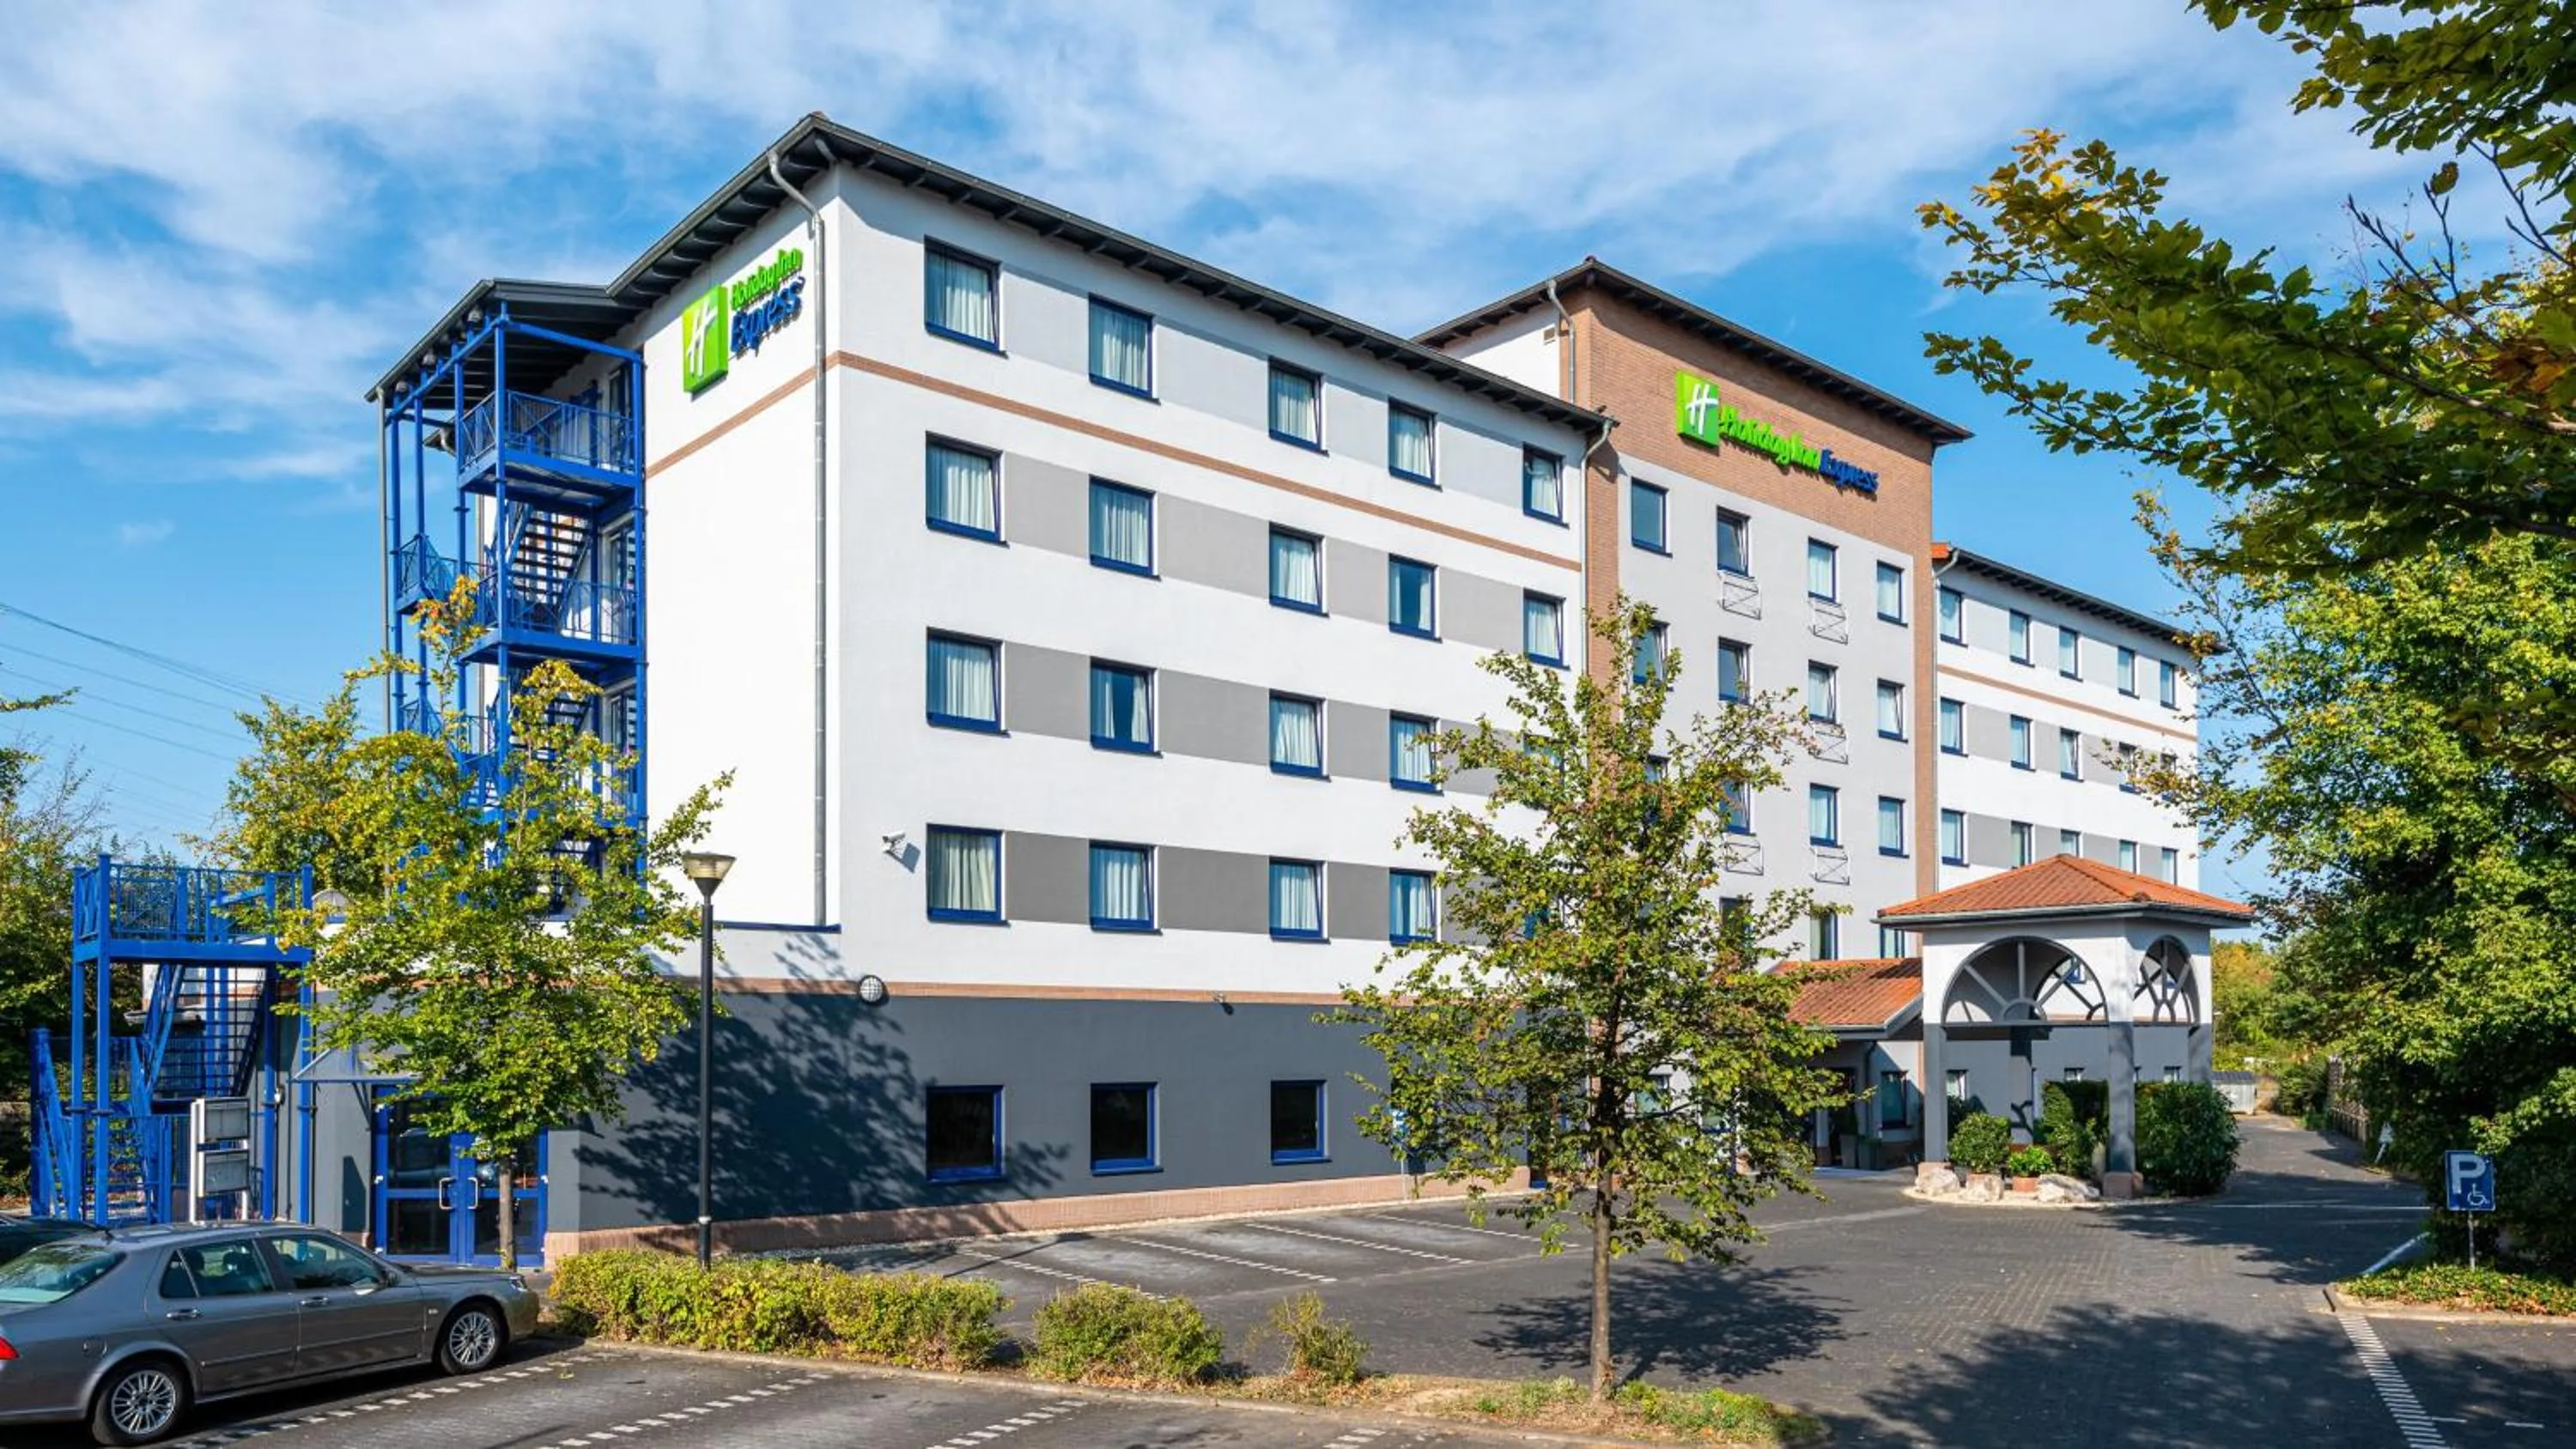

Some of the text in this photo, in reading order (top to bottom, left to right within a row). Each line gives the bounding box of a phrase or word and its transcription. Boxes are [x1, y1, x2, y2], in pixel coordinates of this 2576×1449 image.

[731, 247, 804, 311] Holiday Inn
[732, 276, 805, 353] Express
[1718, 404, 1879, 492] Holiday Inn Express
[2450, 1154, 2487, 1194] P
